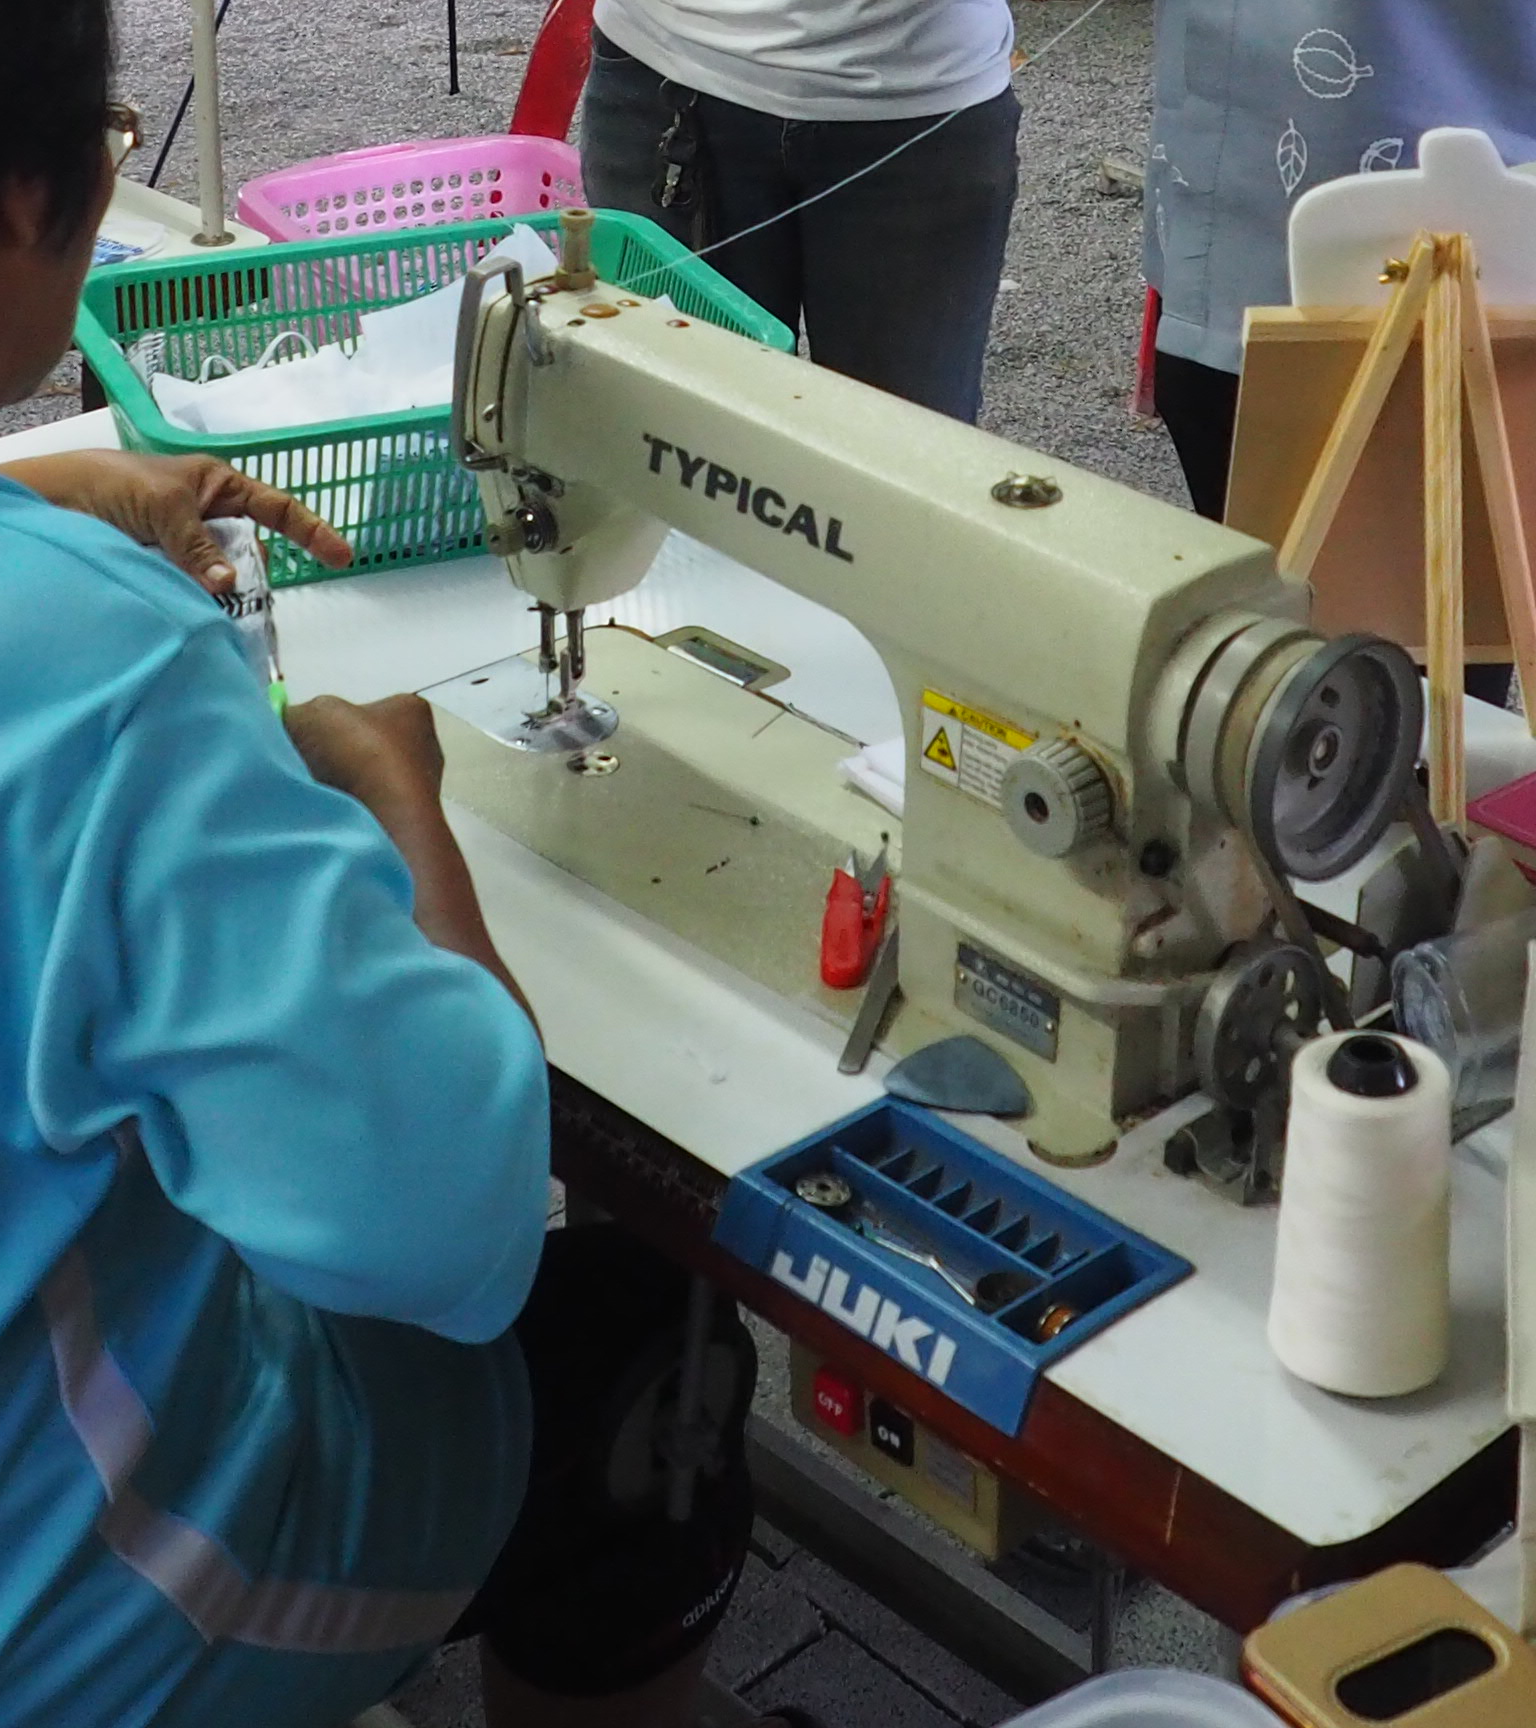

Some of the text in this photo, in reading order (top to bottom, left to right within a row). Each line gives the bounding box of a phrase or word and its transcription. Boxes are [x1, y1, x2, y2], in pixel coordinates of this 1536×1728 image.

[643, 432, 855, 564] TYPICAL
[770, 1248, 958, 1387] JUKI
[877, 1425, 901, 1450] ON
